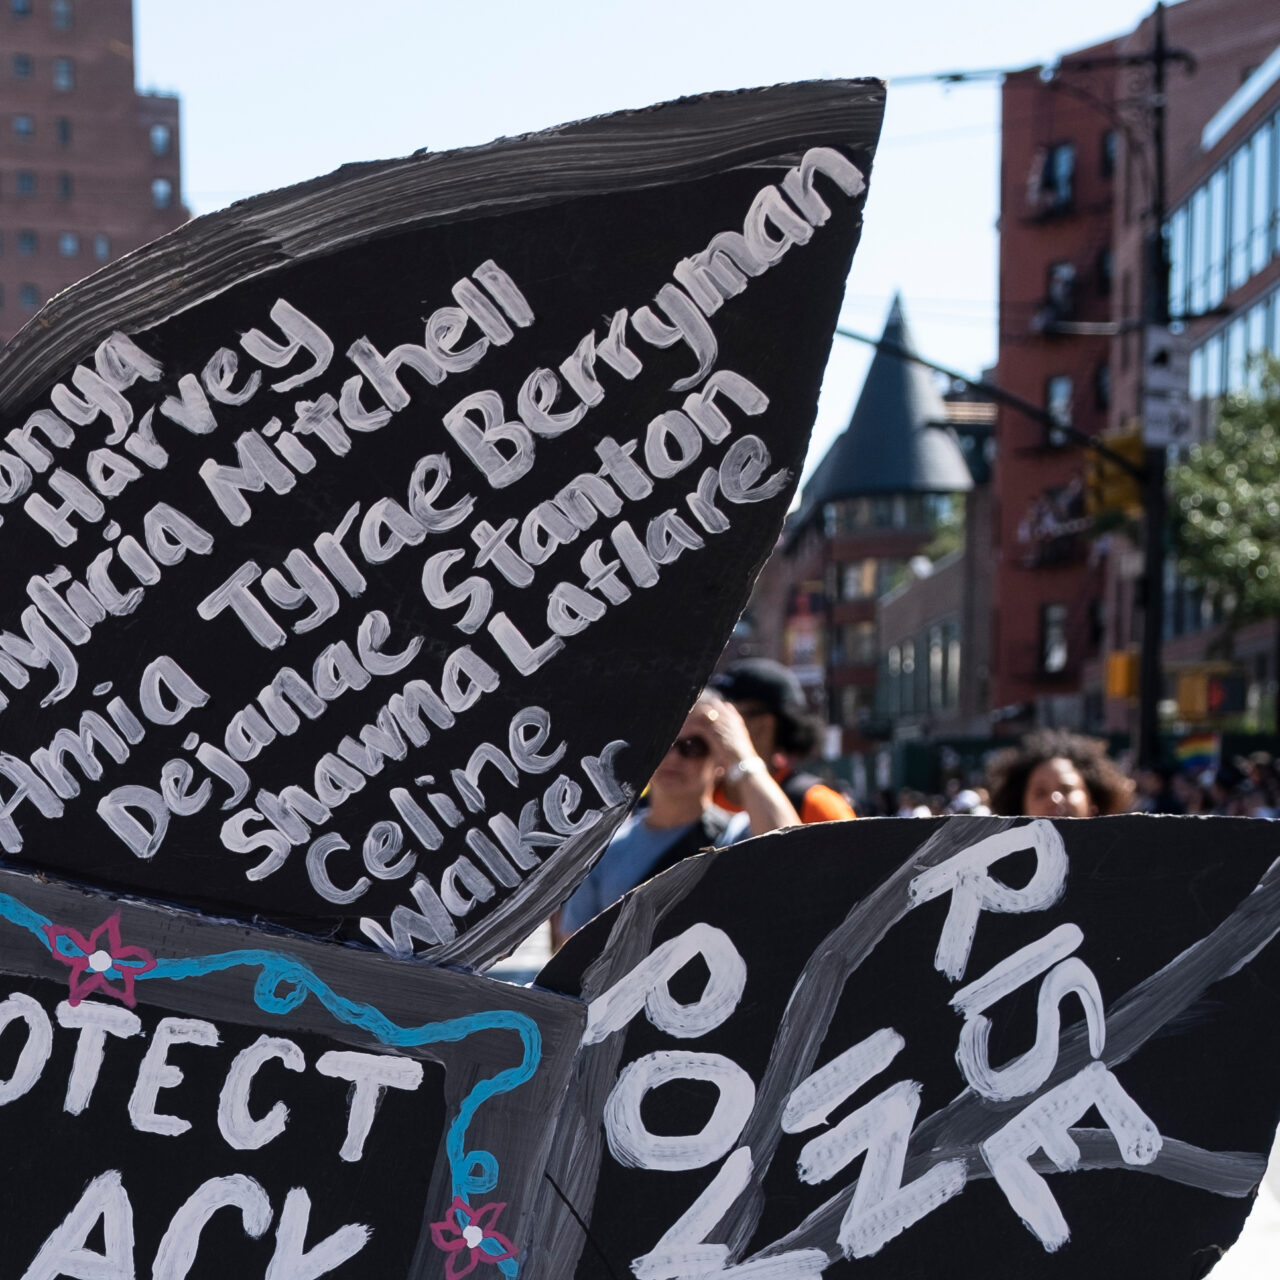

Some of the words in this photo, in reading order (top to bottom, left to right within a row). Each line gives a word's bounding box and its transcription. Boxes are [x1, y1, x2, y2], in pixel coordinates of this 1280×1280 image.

[24, 297, 335, 548] Harvey
[197, 452, 476, 649] Tyrae
[443, 146, 866, 488] Berryman
[199, 259, 535, 527] Mitchell
[97, 609, 425, 860] Dejanae
[422, 369, 770, 635] Stanton
[220, 645, 500, 882] Shawna
[487, 434, 795, 676] Laflare
[306, 705, 568, 905] Celine
[359, 739, 635, 960] Walker
[780, 1026, 968, 1260] IN
[908, 818, 1164, 1254] RISE
